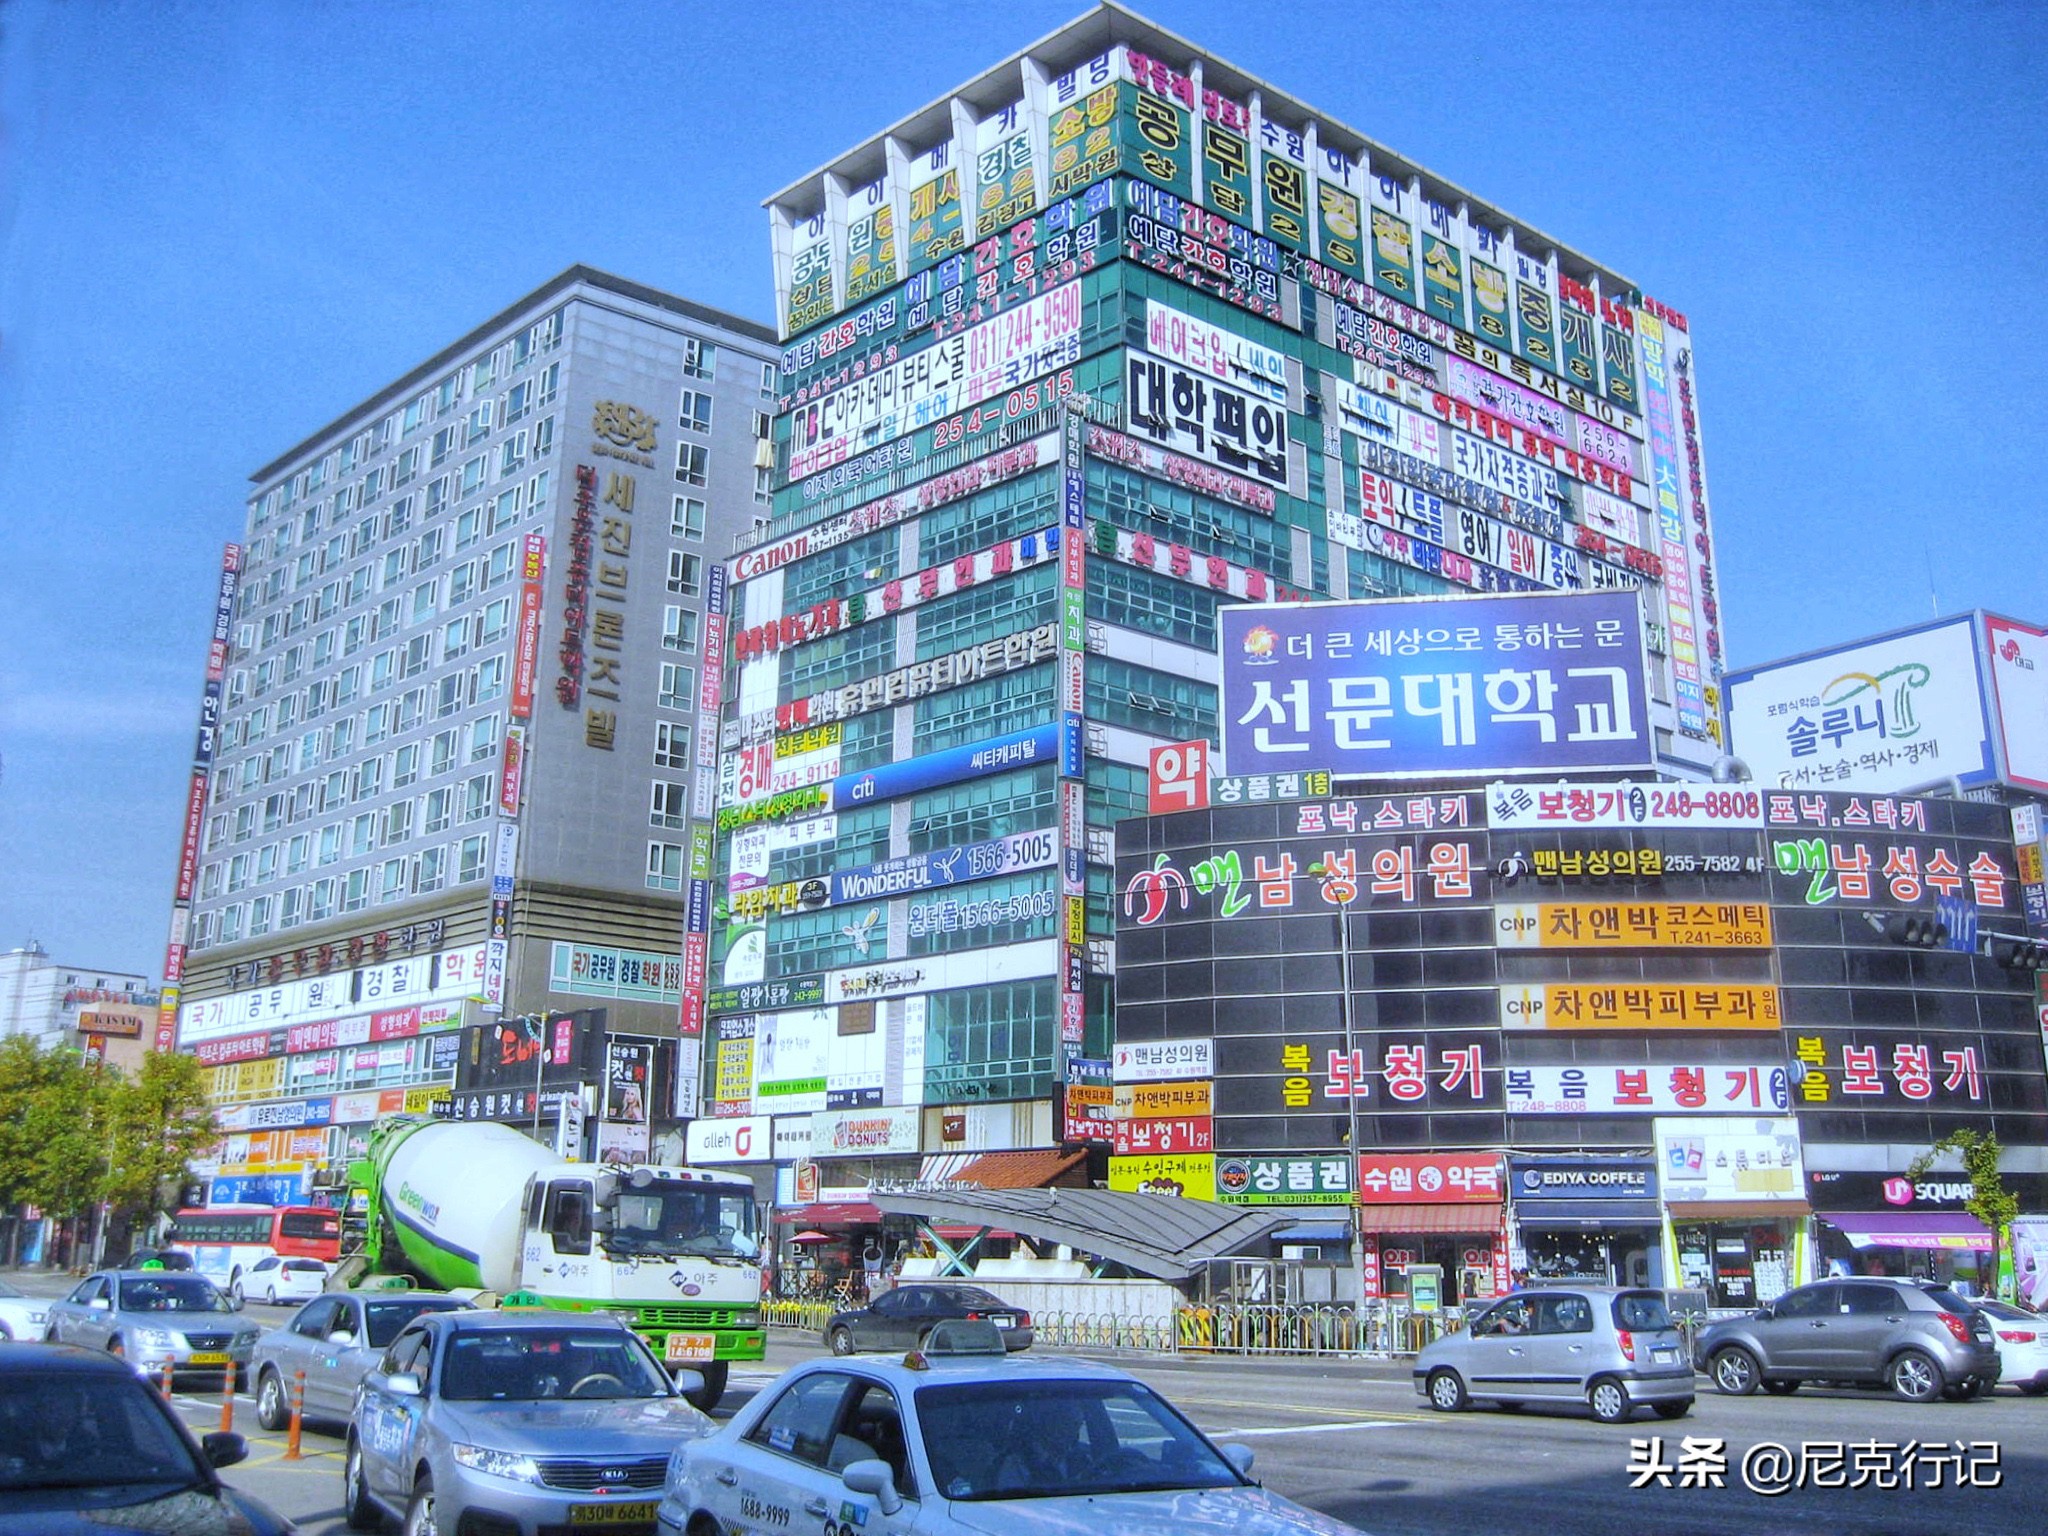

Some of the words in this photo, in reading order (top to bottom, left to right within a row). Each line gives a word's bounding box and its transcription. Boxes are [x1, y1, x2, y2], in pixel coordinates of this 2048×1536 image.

[1057, 52, 1109, 103] 빌딩
[1053, 85, 1118, 147] 소방
[1261, 118, 1305, 162] 수원
[781, 297, 897, 376] 예담간호학원
[934, 368, 1075, 449] 254-0515
[1129, 357, 1288, 485] 대학편입
[803, 436, 913, 499] 이지외국어학원
[1362, 472, 1395, 527] 토익
[1461, 511, 1492, 562] 영어
[1507, 528, 1536, 580] 일어
[736, 536, 808, 581] Canon
[1067, 605, 1082, 648] 치과
[1287, 632, 1314, 661] 더
[1325, 631, 1354, 658] 큰
[1364, 626, 1483, 655] 세상으로
[1493, 621, 1583, 652] 통하는
[1593, 620, 1625, 648] 문
[1238, 665, 1638, 754] 선문대학교
[1786, 698, 1887, 758] 솔루니
[740, 742, 773, 798] 경매
[775, 722, 840, 760] 전문학원
[773, 760, 839, 792] 244-9114
[852, 778, 874, 800] citi
[970, 738, 1037, 769] 씨티캐피탈
[1156, 746, 1201, 807] 약
[1218, 774, 1300, 803] 상품권
[1304, 772, 1330, 796] 1층
[1537, 789, 1626, 822] 보청기
[1651, 791, 1760, 818] 248-8808
[841, 866, 932, 899] WONDERFUL
[967, 834, 1053, 876] 1566-5005
[1532, 848, 1663, 877] 맨남성의원
[1664, 854, 1741, 872] 255-7582
[1744, 857, 1765, 872] 4F
[908, 899, 959, 938] 원더풀
[959, 890, 1055, 931] 1566-5005
[1500, 917, 1537, 931] CNP
[1550, 907, 1660, 941] 차앤박
[1666, 904, 1765, 928] 코스메틱
[1669, 930, 1763, 945] T.241-3663
[591, 953, 616, 985] 공무원
[621, 958, 640, 985] 경찰
[641, 961, 661, 986] 학원
[191, 1002, 225, 1026] 국가
[366, 963, 411, 998] 경찰
[1506, 1000, 1543, 1014] CNP
[1553, 988, 1756, 1021] 차앤박피부과
[611, 1045, 639, 1059] 신승원
[1135, 1044, 1209, 1067] 맨남성의원
[1796, 1036, 1832, 1102] 복음
[1842, 1044, 1982, 1101] 보청기
[1281, 1043, 1313, 1107] 복음
[1324, 1044, 1484, 1101] 보청기
[1506, 1068, 1588, 1100] 복음
[1613, 1066, 1761, 1107] 보청기
[453, 1096, 496, 1119] 신승원
[1115, 1098, 1132, 1107] CNP
[1135, 1088, 1210, 1109] 차앤박피부과
[848, 1132, 892, 1147] DONUTS
[1117, 1121, 1130, 1152] 복음
[1132, 1121, 1195, 1150] 보청기
[1196, 1132, 1210, 1147] 2F
[1252, 1161, 1347, 1192] 상품권
[1364, 1166, 1412, 1193] 수원
[1446, 1165, 1497, 1192] 약국
[1543, 1171, 1588, 1185] EDIYA
[1588, 1171, 1646, 1185] COFFEE
[526, 1246, 541, 1262] 662
[571, 1263, 590, 1278] 아주
[693, 1271, 719, 1286] 아주
[605, 1470, 625, 1479] KIA
